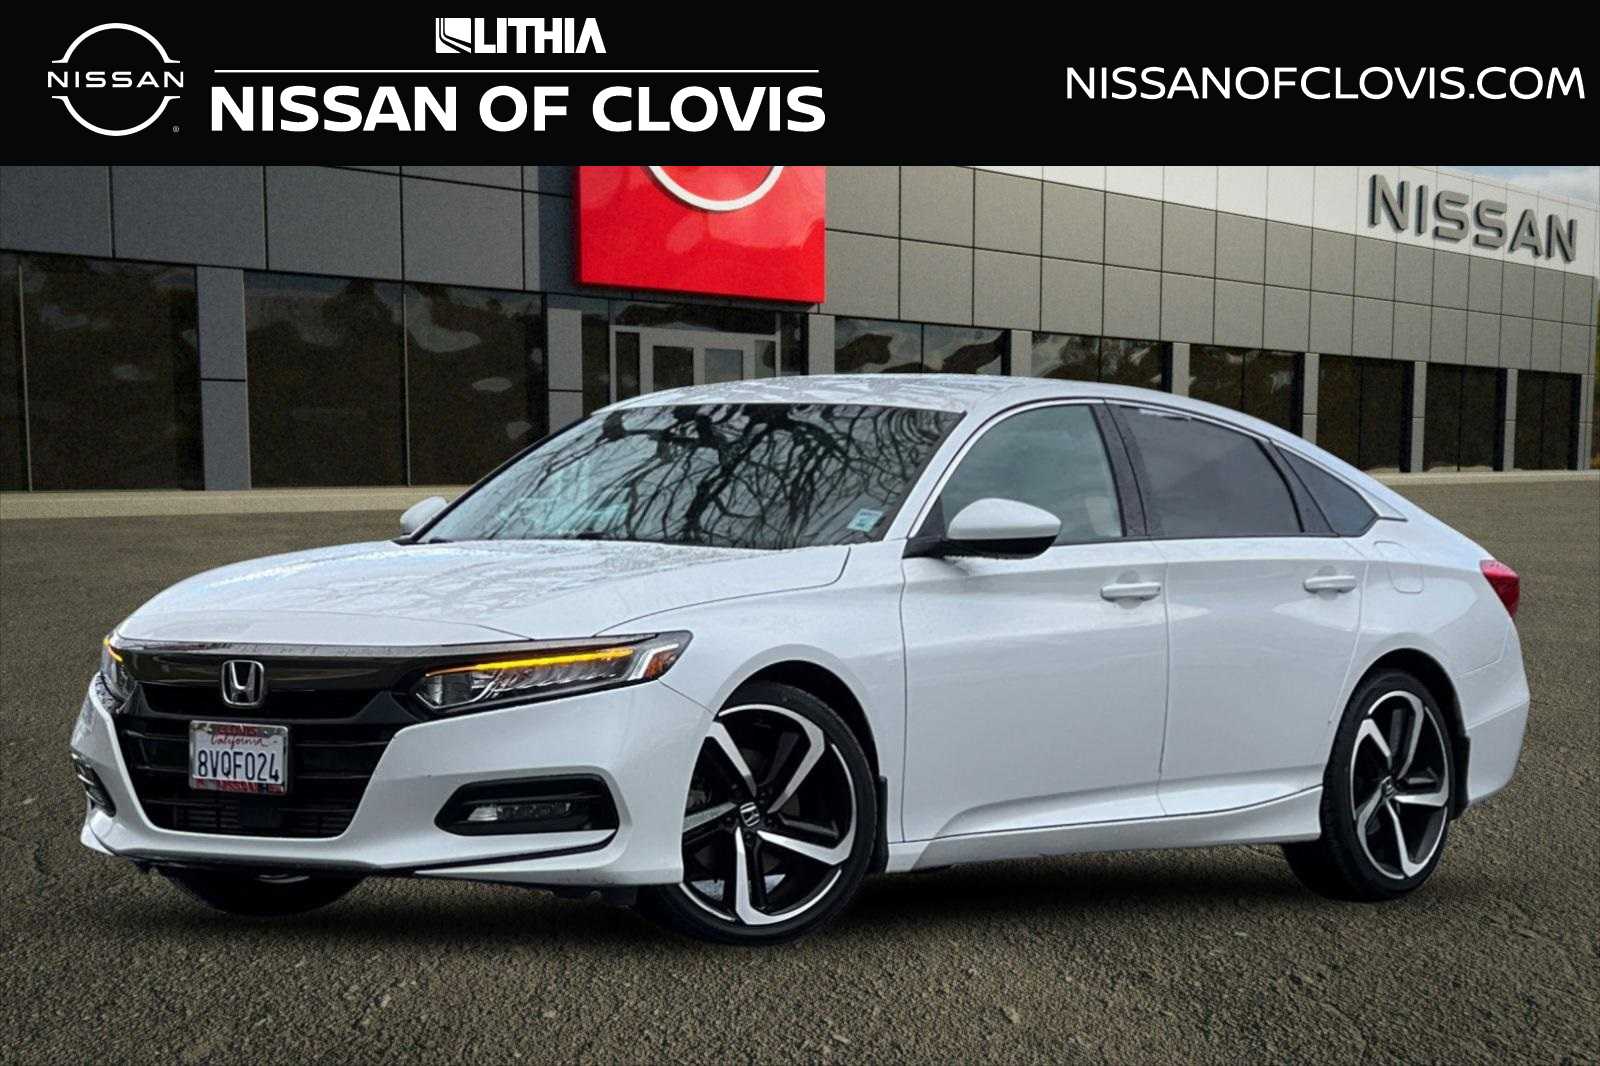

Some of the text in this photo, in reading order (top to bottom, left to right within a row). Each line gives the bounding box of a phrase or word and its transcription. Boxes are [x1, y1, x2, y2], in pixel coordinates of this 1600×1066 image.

[1368, 174, 1577, 263] NISSAN
[211, 733, 268, 750] California
[198, 749, 280, 782] 8VQF024
